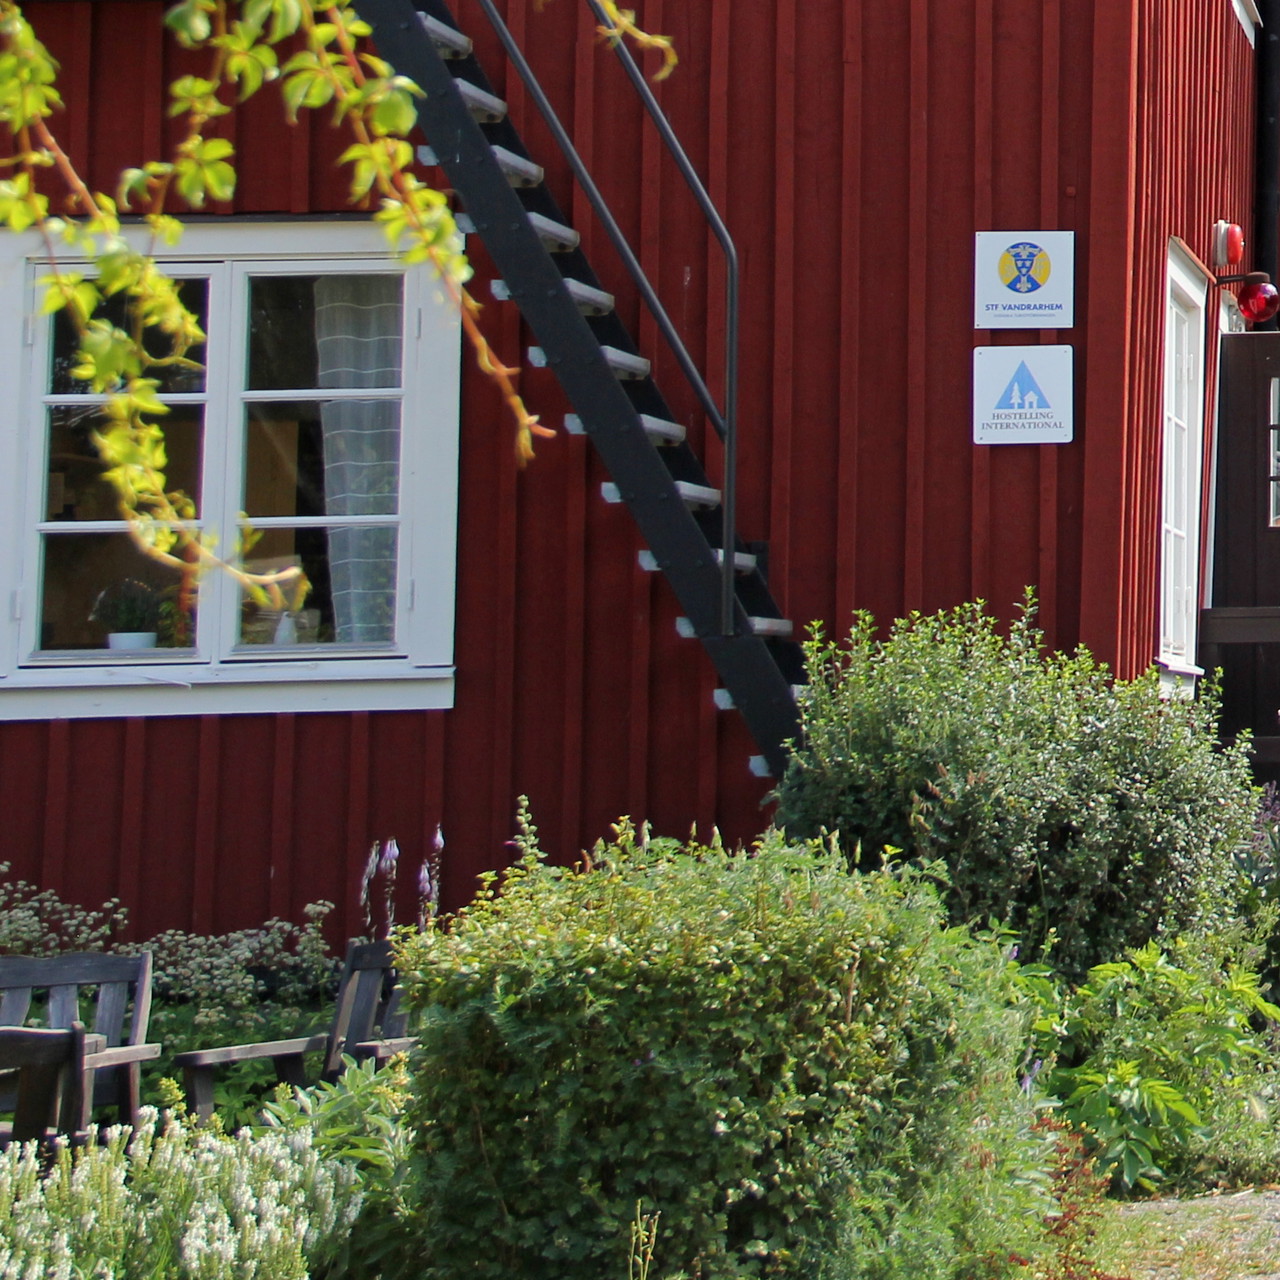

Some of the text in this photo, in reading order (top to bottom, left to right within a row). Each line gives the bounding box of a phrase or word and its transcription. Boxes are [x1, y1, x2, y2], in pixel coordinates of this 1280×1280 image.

[985, 303, 1063, 311] STF VANDRARHEM
[992, 412, 1054, 420] HOSTELLING
[981, 421, 1065, 430] INTERNATIONAL
